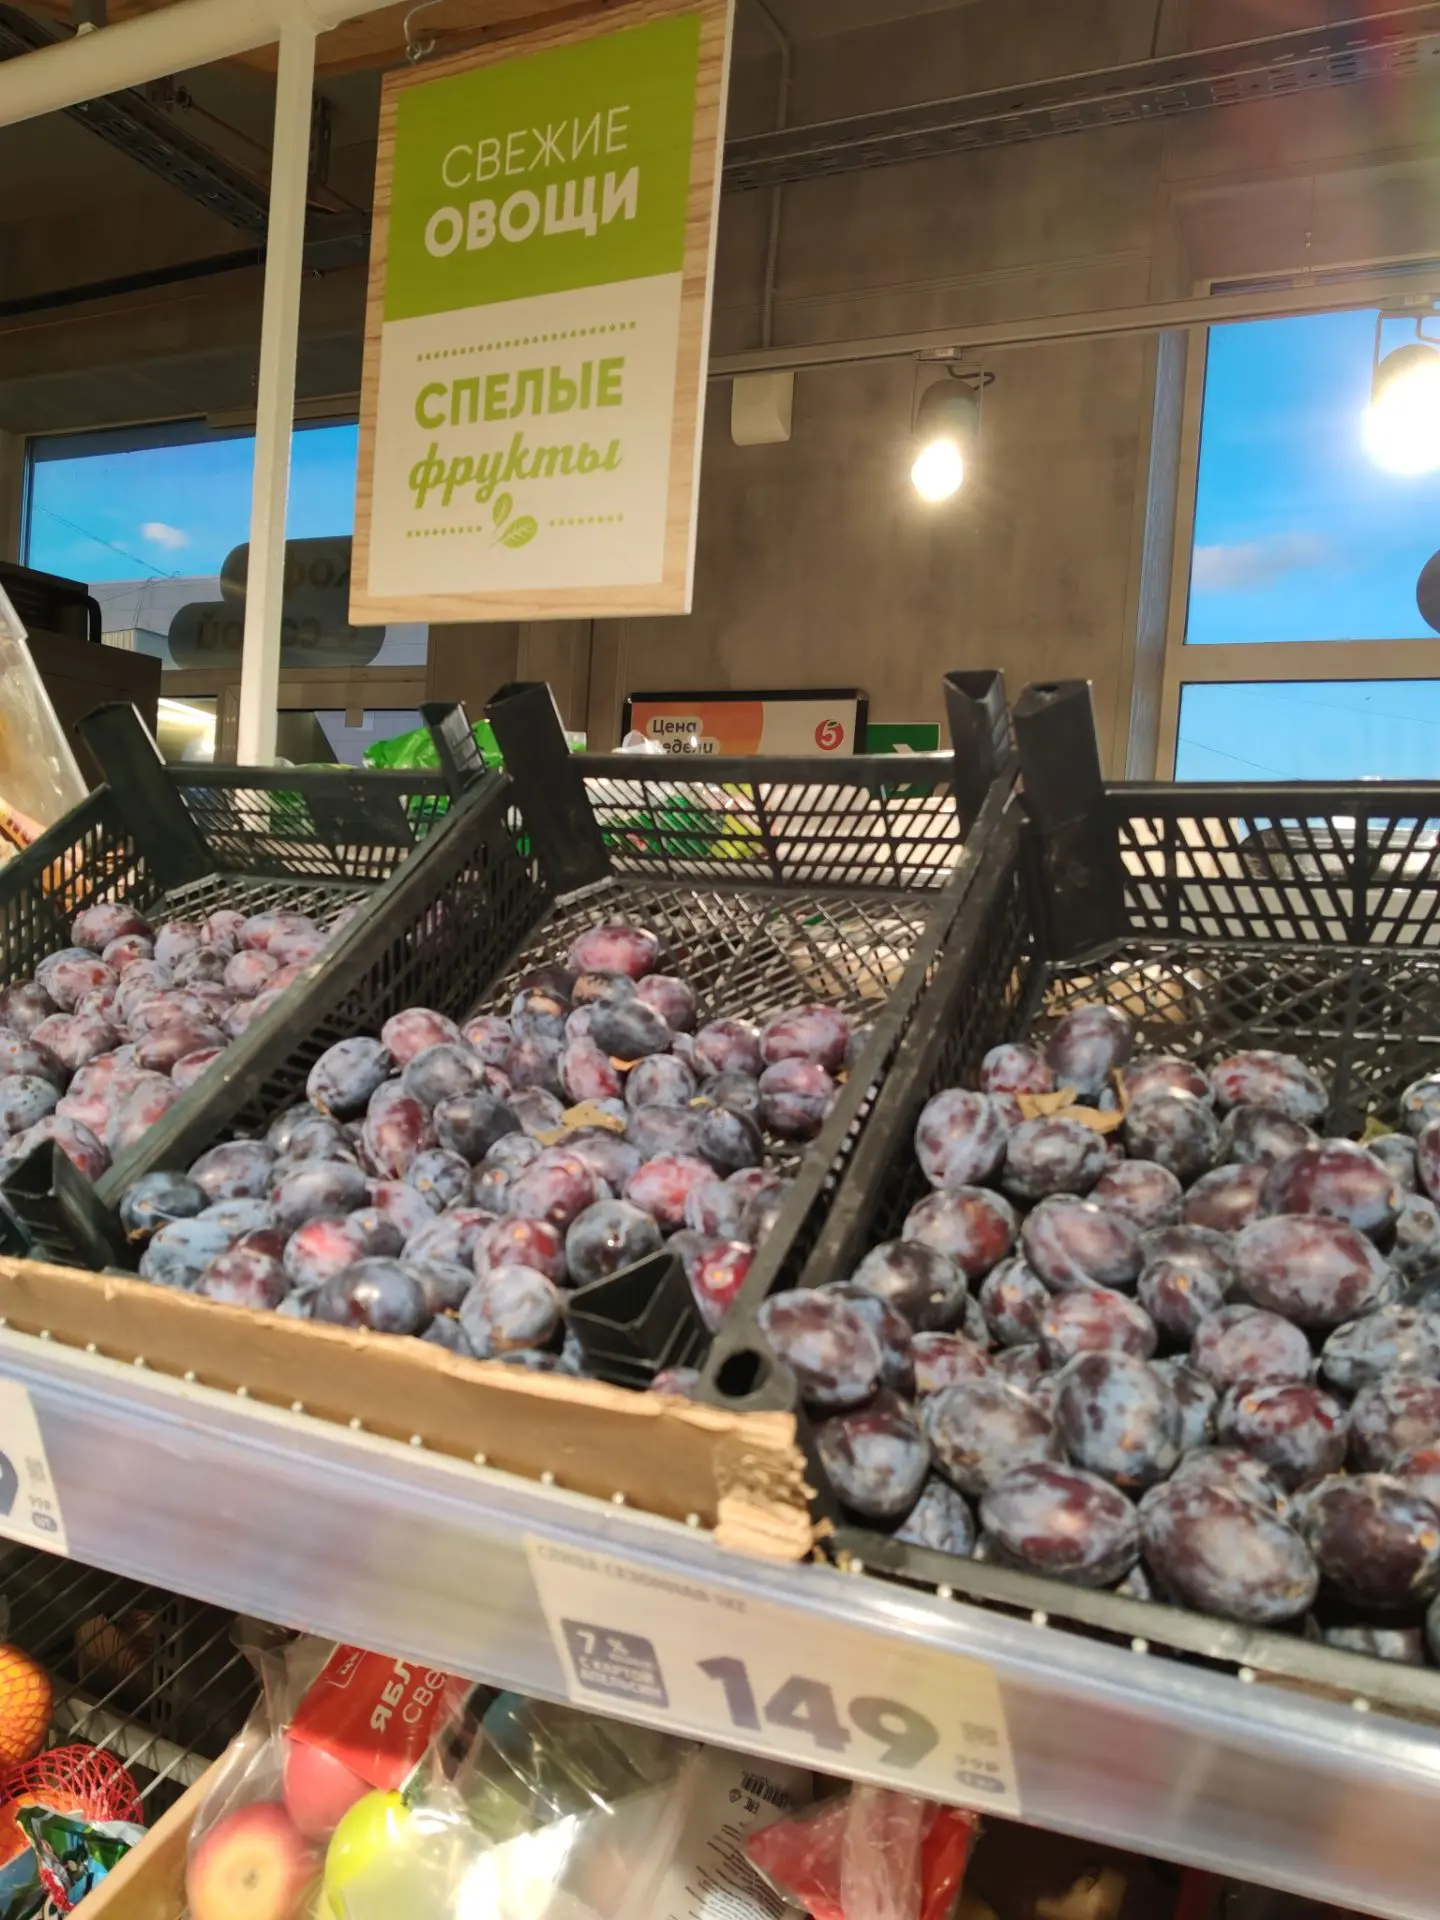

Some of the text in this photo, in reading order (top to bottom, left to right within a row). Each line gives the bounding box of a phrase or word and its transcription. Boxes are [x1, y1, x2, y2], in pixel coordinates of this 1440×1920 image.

[441, 105, 631, 189] СВЕЖИЕ
[424, 166, 640, 258] ОВОЩИ
[414, 356, 626, 430] СПЕЛЫЕ
[408, 432, 623, 509] фрукты
[652, 719, 697, 736] Цена
[662, 739, 713, 754] едели
[370, 1659, 411, 1734] ЯБЛ
[697, 1656, 939, 1769] 149
